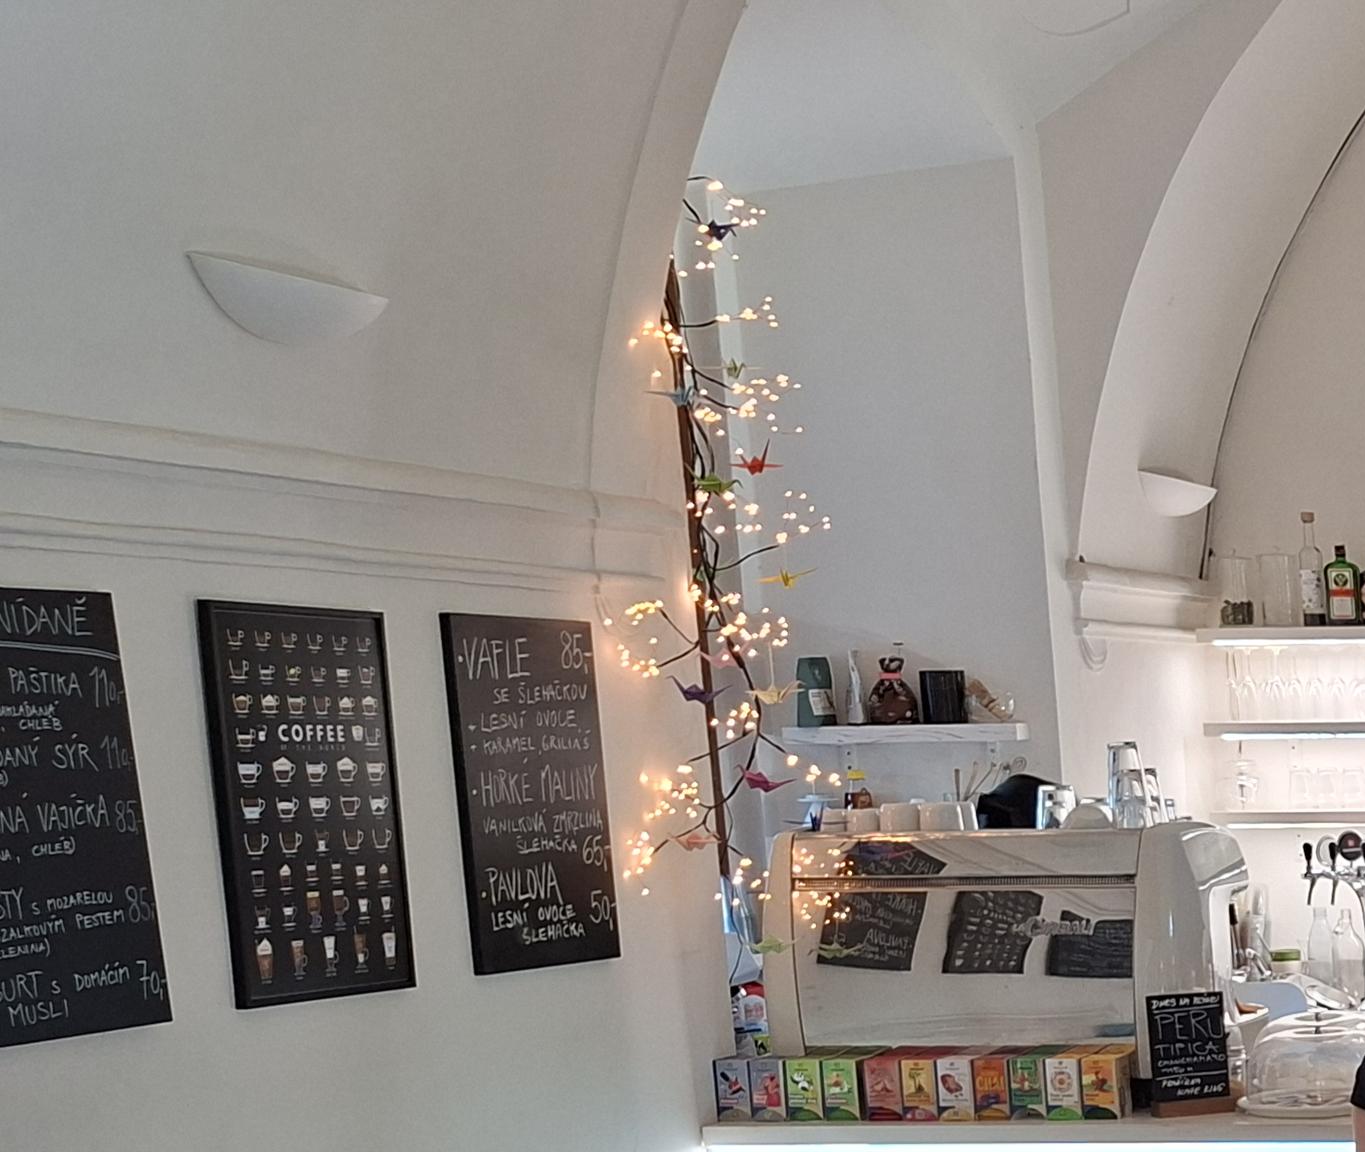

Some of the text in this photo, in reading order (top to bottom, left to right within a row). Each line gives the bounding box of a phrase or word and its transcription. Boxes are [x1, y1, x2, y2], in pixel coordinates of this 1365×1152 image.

[463, 637, 531, 680] VAFLE
[8, 666, 82, 698] PAŠTIKA
[493, 680, 587, 704] SE ŠLEHAČKOU
[278, 724, 345, 742] COFFEE
[481, 709, 578, 732] LESNÍ OVOCE
[52, 733, 99, 772] SÝR
[481, 757, 598, 807] HORKÉ MALINY
[37, 793, 110, 832] VAJÍČKA
[483, 808, 603, 837] VANILKOVÁ ZMRZLINA
[484, 861, 563, 906] PAVLOVA
[47, 891, 113, 912] MOZARELOU
[75, 909, 125, 930] PESTEM
[491, 902, 576, 931] LESNÍ OVOCE
[74, 961, 130, 991] DOMÁCÍM
[8, 998, 69, 1027] MUSLI
[1154, 1010, 1223, 1039] PERU
[1154, 1042, 1219, 1057] TIPICA
